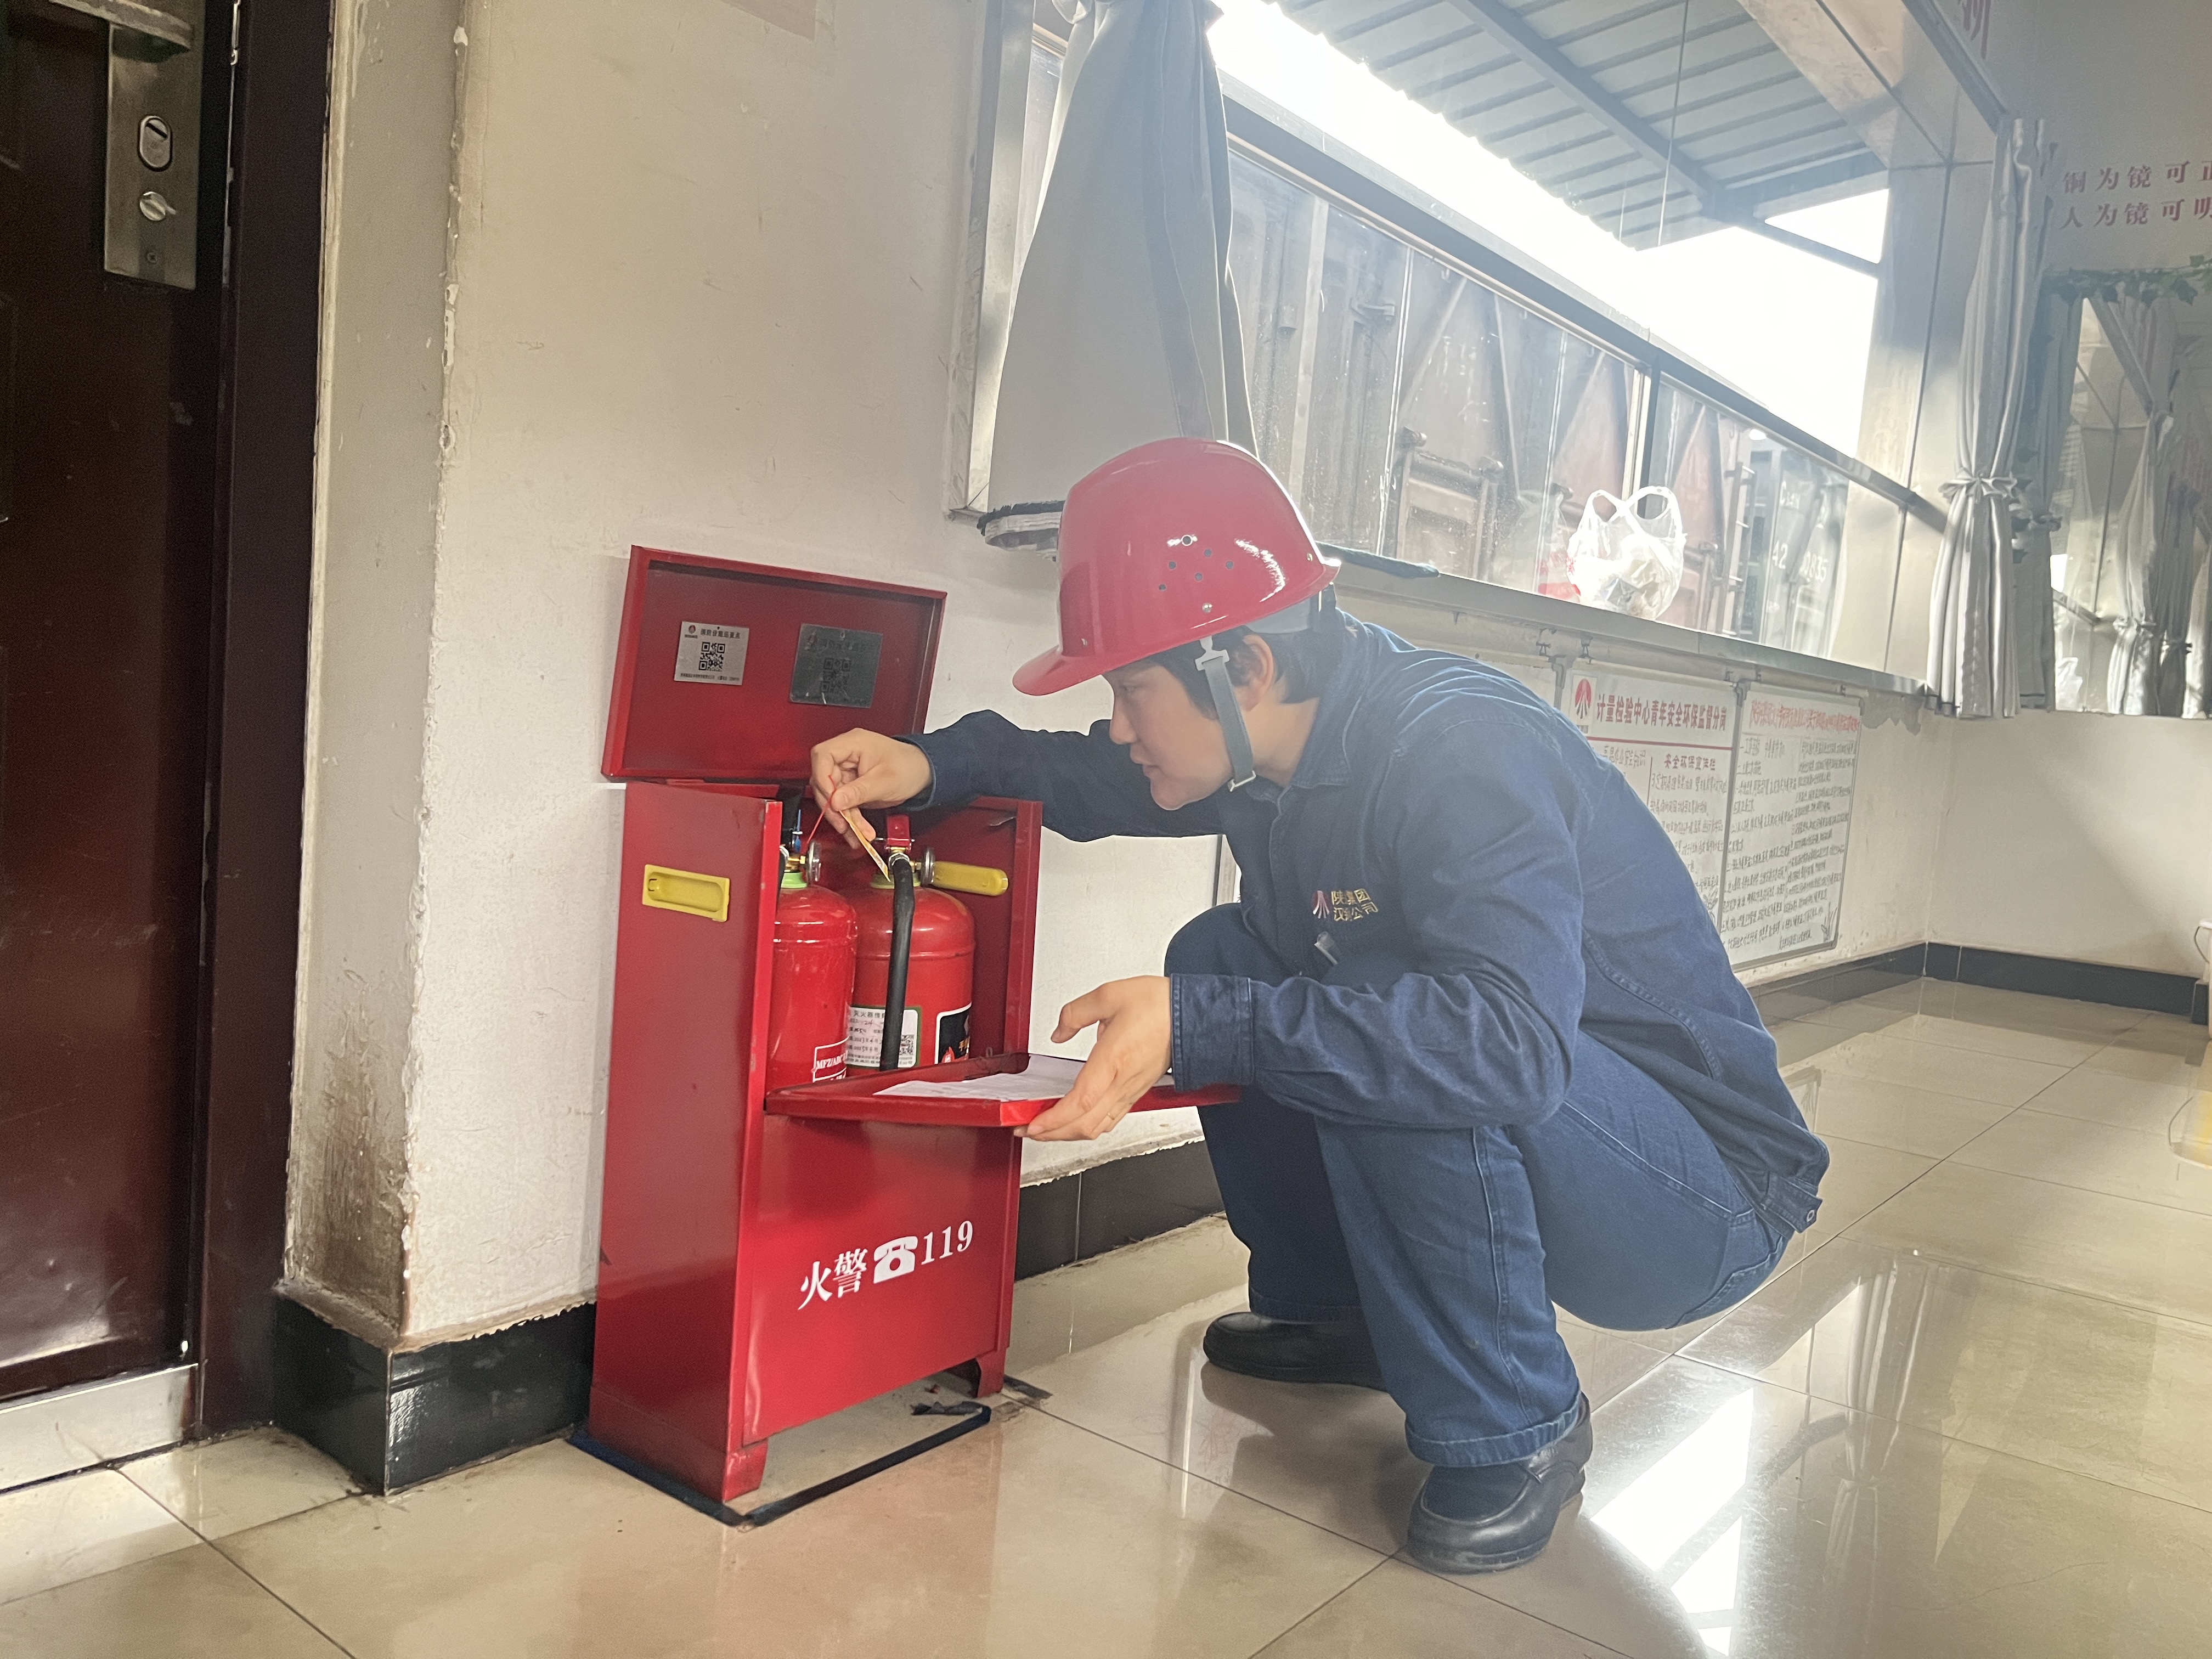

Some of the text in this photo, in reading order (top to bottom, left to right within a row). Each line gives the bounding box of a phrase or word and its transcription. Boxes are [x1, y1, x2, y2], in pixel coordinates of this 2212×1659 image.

[1331, 888, 1371, 905] 陕集团
[798, 1220, 973, 1310] 火警 119
